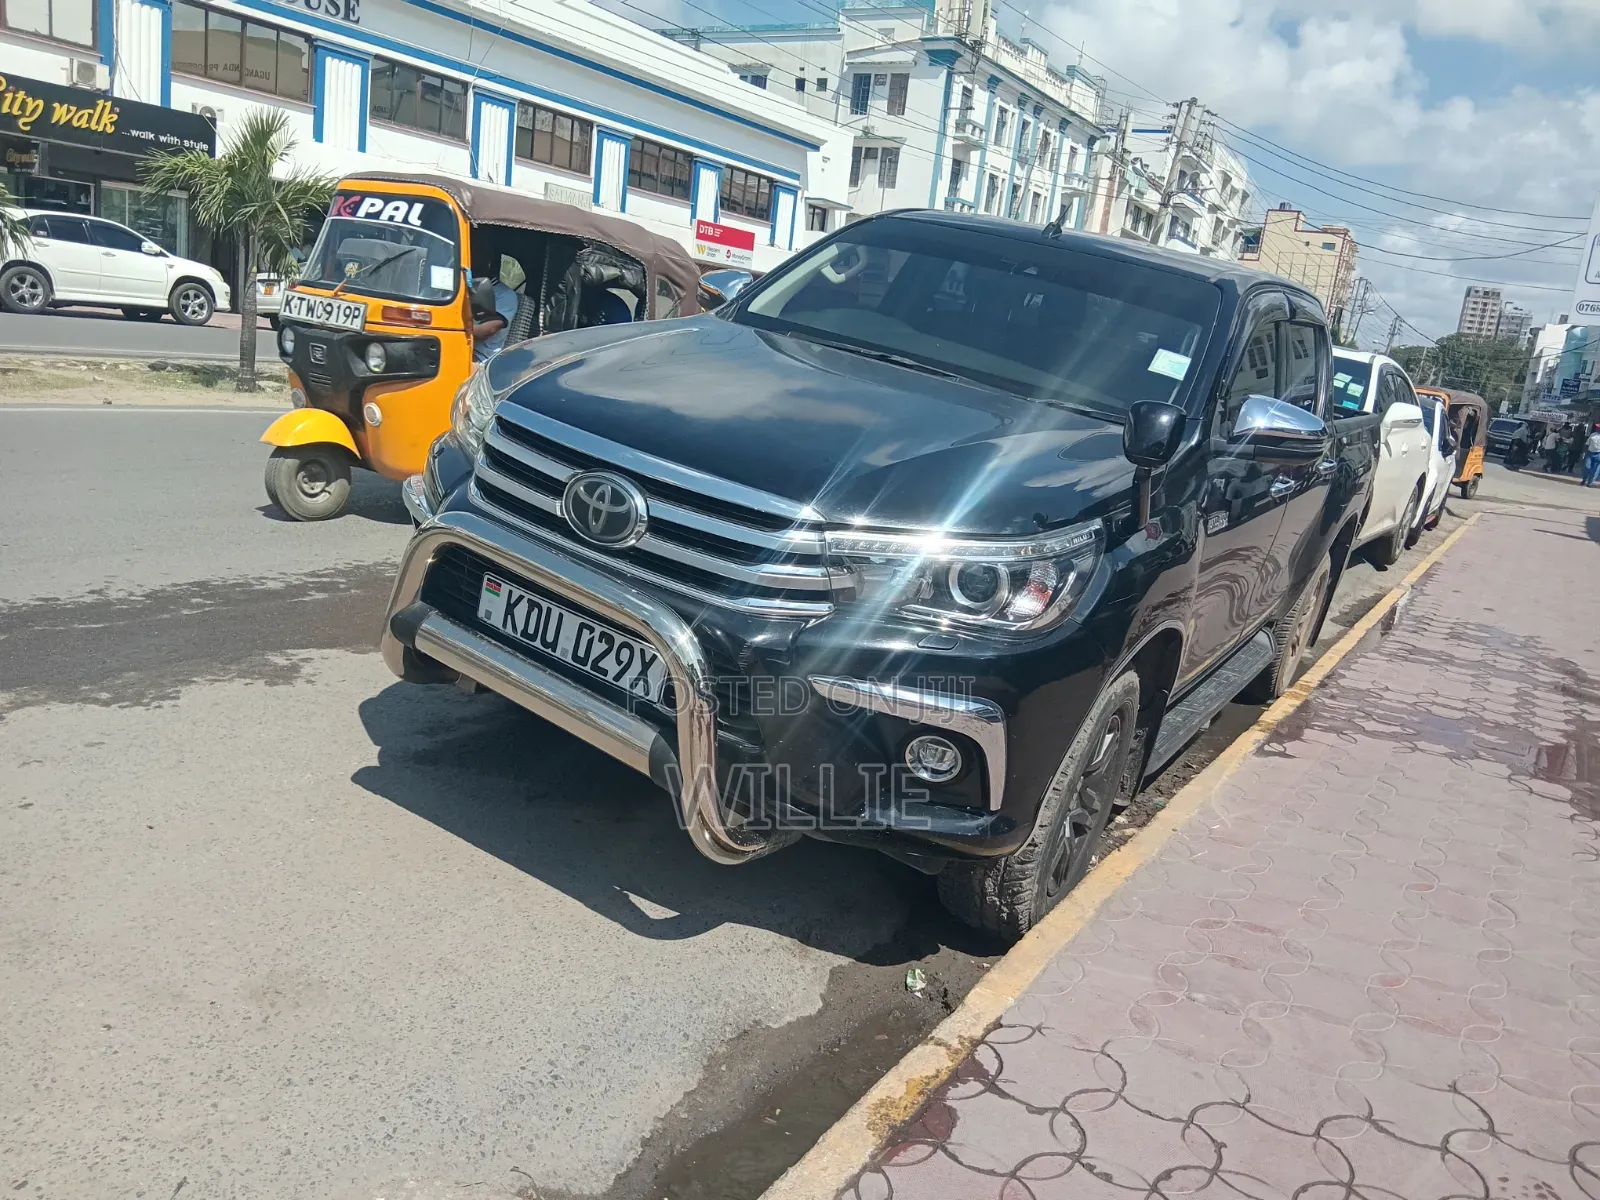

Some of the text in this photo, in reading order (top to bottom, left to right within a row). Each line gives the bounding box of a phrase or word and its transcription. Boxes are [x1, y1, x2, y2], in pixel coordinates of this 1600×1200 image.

[51, 99, 120, 134] walk
[158, 133, 181, 147] with
[184, 139, 210, 152] style
[699, 225, 714, 236] DTB
[502, 589, 657, 698] KDU 029X
